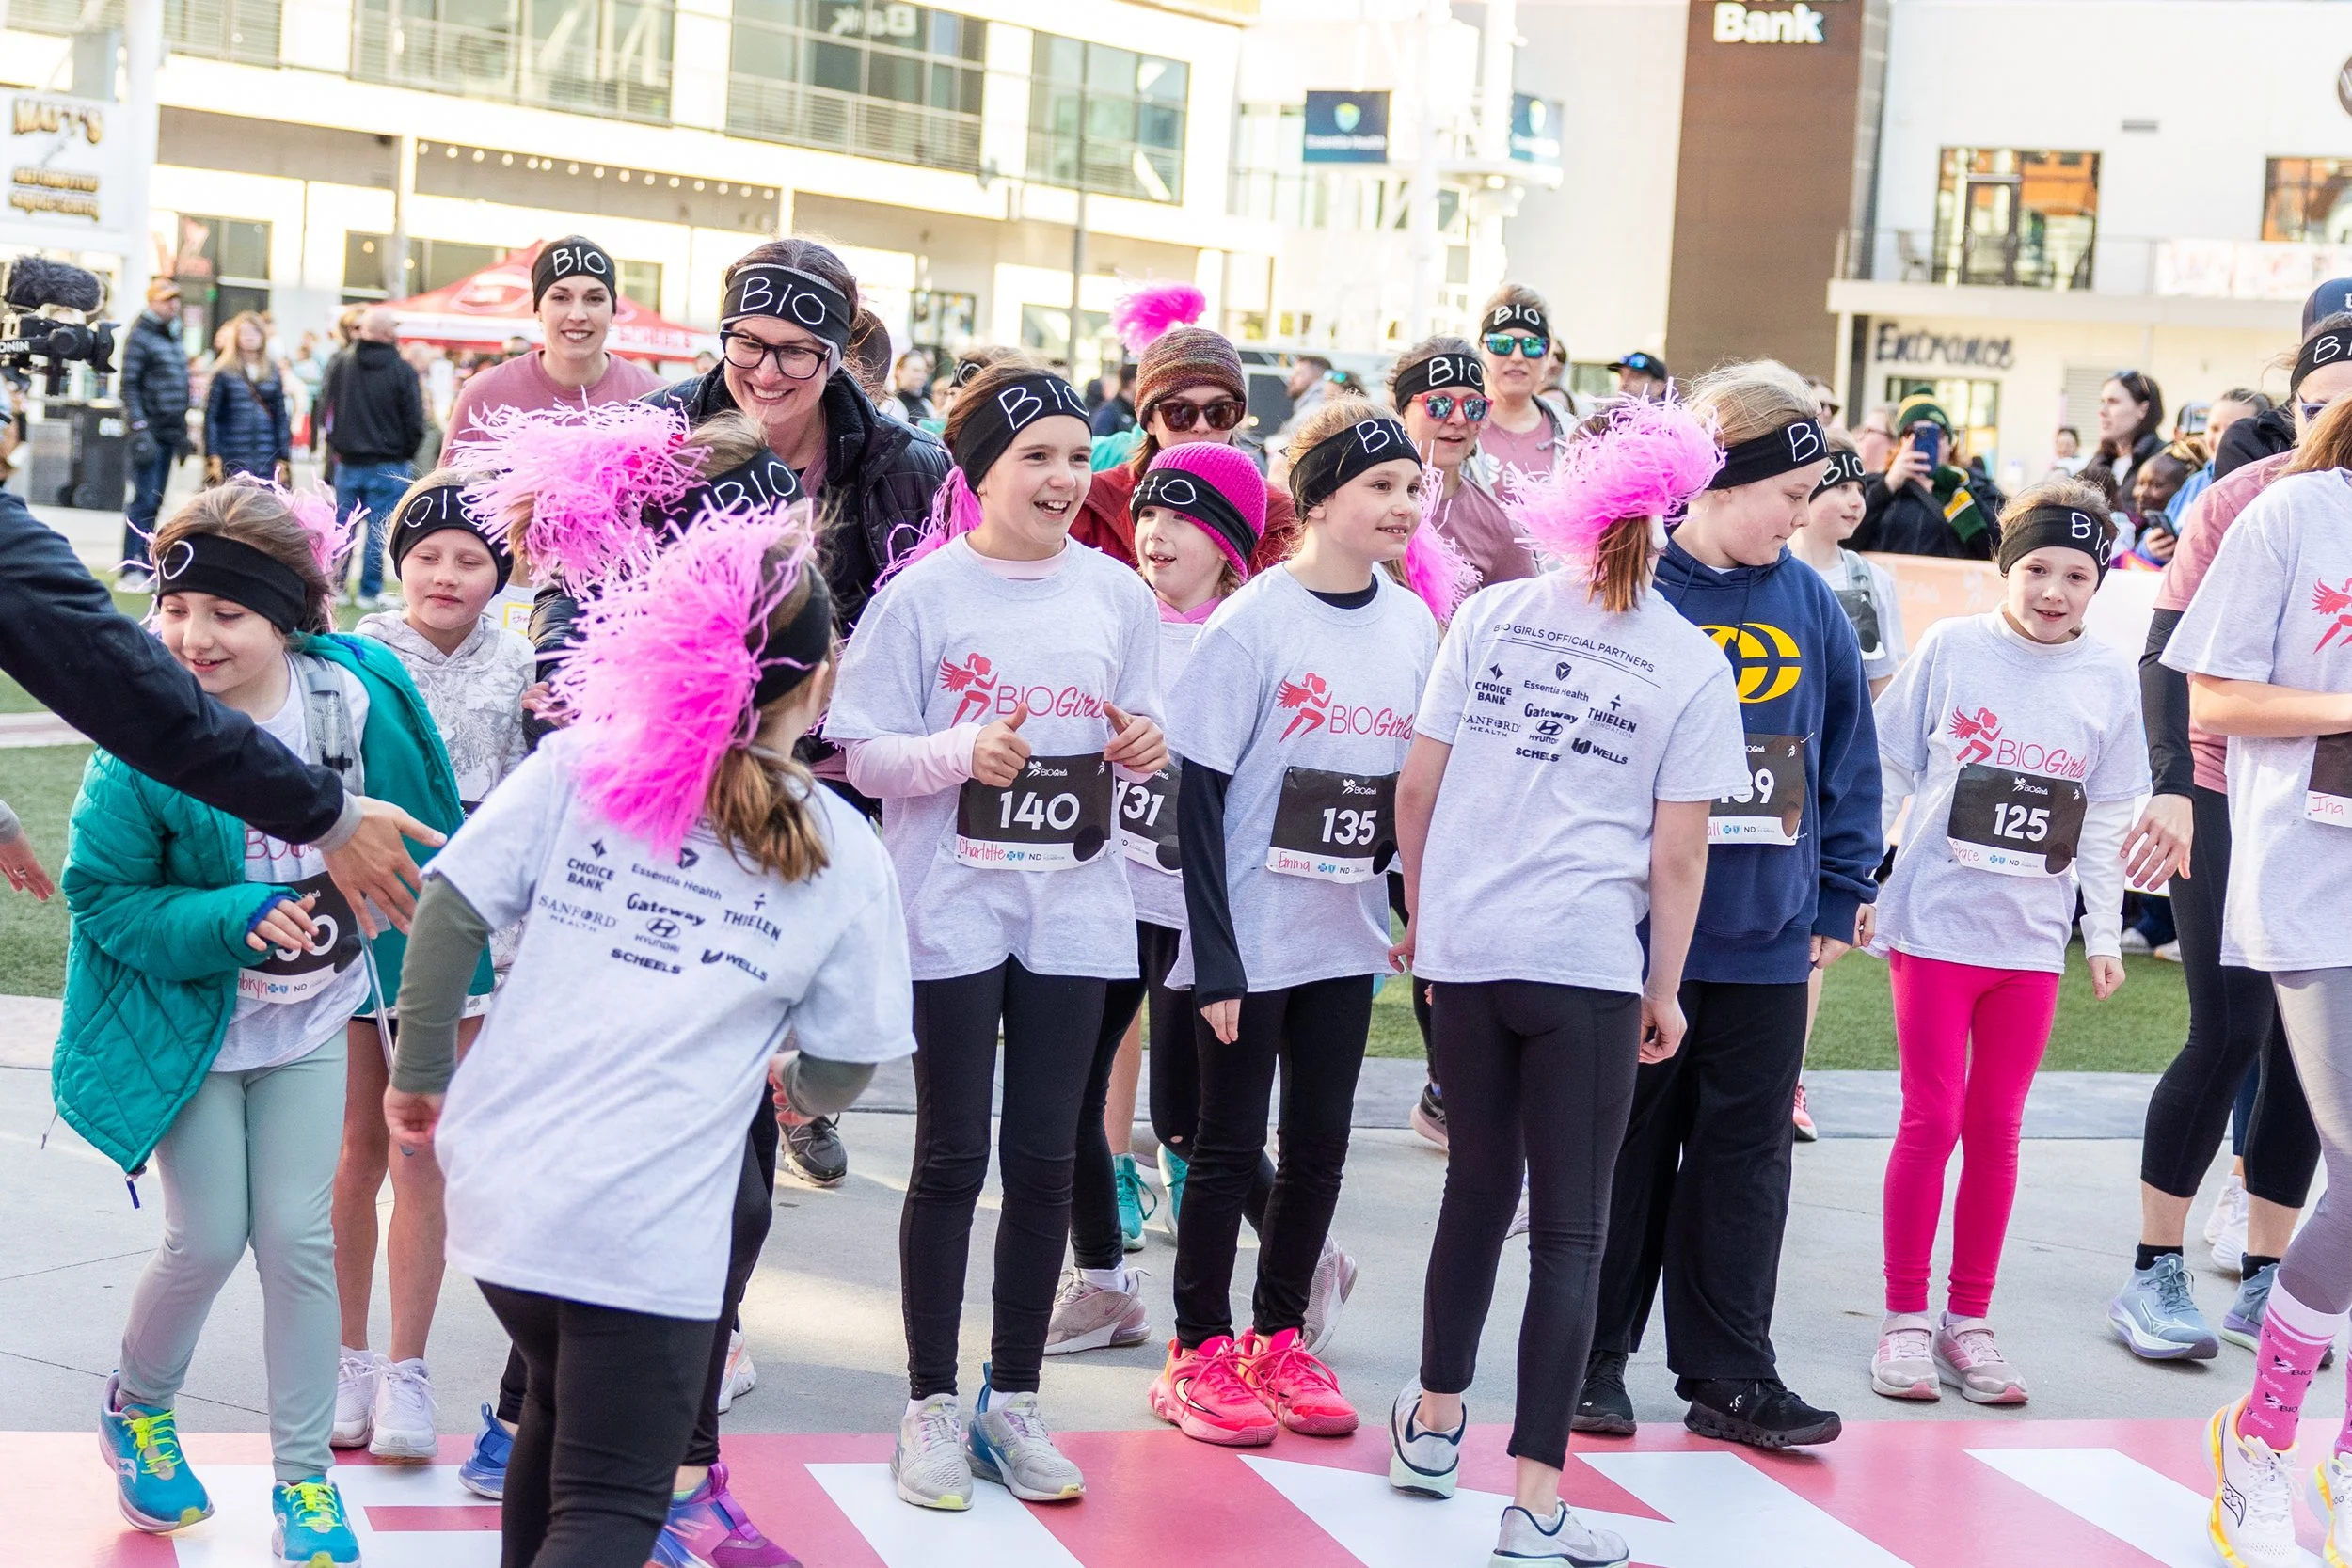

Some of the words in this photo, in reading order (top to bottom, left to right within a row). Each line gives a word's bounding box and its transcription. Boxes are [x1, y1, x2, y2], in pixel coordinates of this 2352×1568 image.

[1713, 2, 1825, 43] Bank
[552, 246, 607, 277] BIO
[740, 277, 826, 325] BIO
[1493, 303, 1541, 325] BIO
[998, 379, 1089, 430] BIO
[714, 461, 797, 513] BIO
[1513, 625, 1545, 639] GIRLS
[1547, 631, 1596, 650] OFFICIAL
[1597, 642, 1656, 673] PARTNERS
[1474, 681, 1513, 696] CHOICE
[1477, 692, 1507, 705] BANK
[1523, 679, 1560, 696] Essentia
[1561, 688, 1590, 703] Health
[1523, 703, 1579, 724] Gateway
[1587, 707, 1637, 734] THIELEN
[1470, 726, 1508, 737] HEALTH
[1586, 720, 1634, 739] FOUNDATION
[1593, 745, 1629, 765] WELLS
[1000, 790, 1080, 831] 140
[1117, 780, 1165, 827] 131
[1322, 807, 1377, 846] 135
[1994, 803, 2050, 842] 125
[959, 838, 1006, 861] Charlotte
[1028, 852, 1042, 861] ND
[1279, 851, 1311, 873] Emma
[567, 857, 615, 881] CHOICE
[567, 872, 605, 892] BANK
[631, 863, 681, 887] Essentia
[683, 879, 723, 901] Health
[1339, 866, 1351, 875] ND
[538, 895, 617, 928] SANFORD
[627, 893, 706, 927] Gateway
[723, 910, 781, 941] THIELEN
[611, 948, 682, 974] SCHEELS
[726, 952, 768, 981] WELLS
[294, 983, 308, 992] ND
